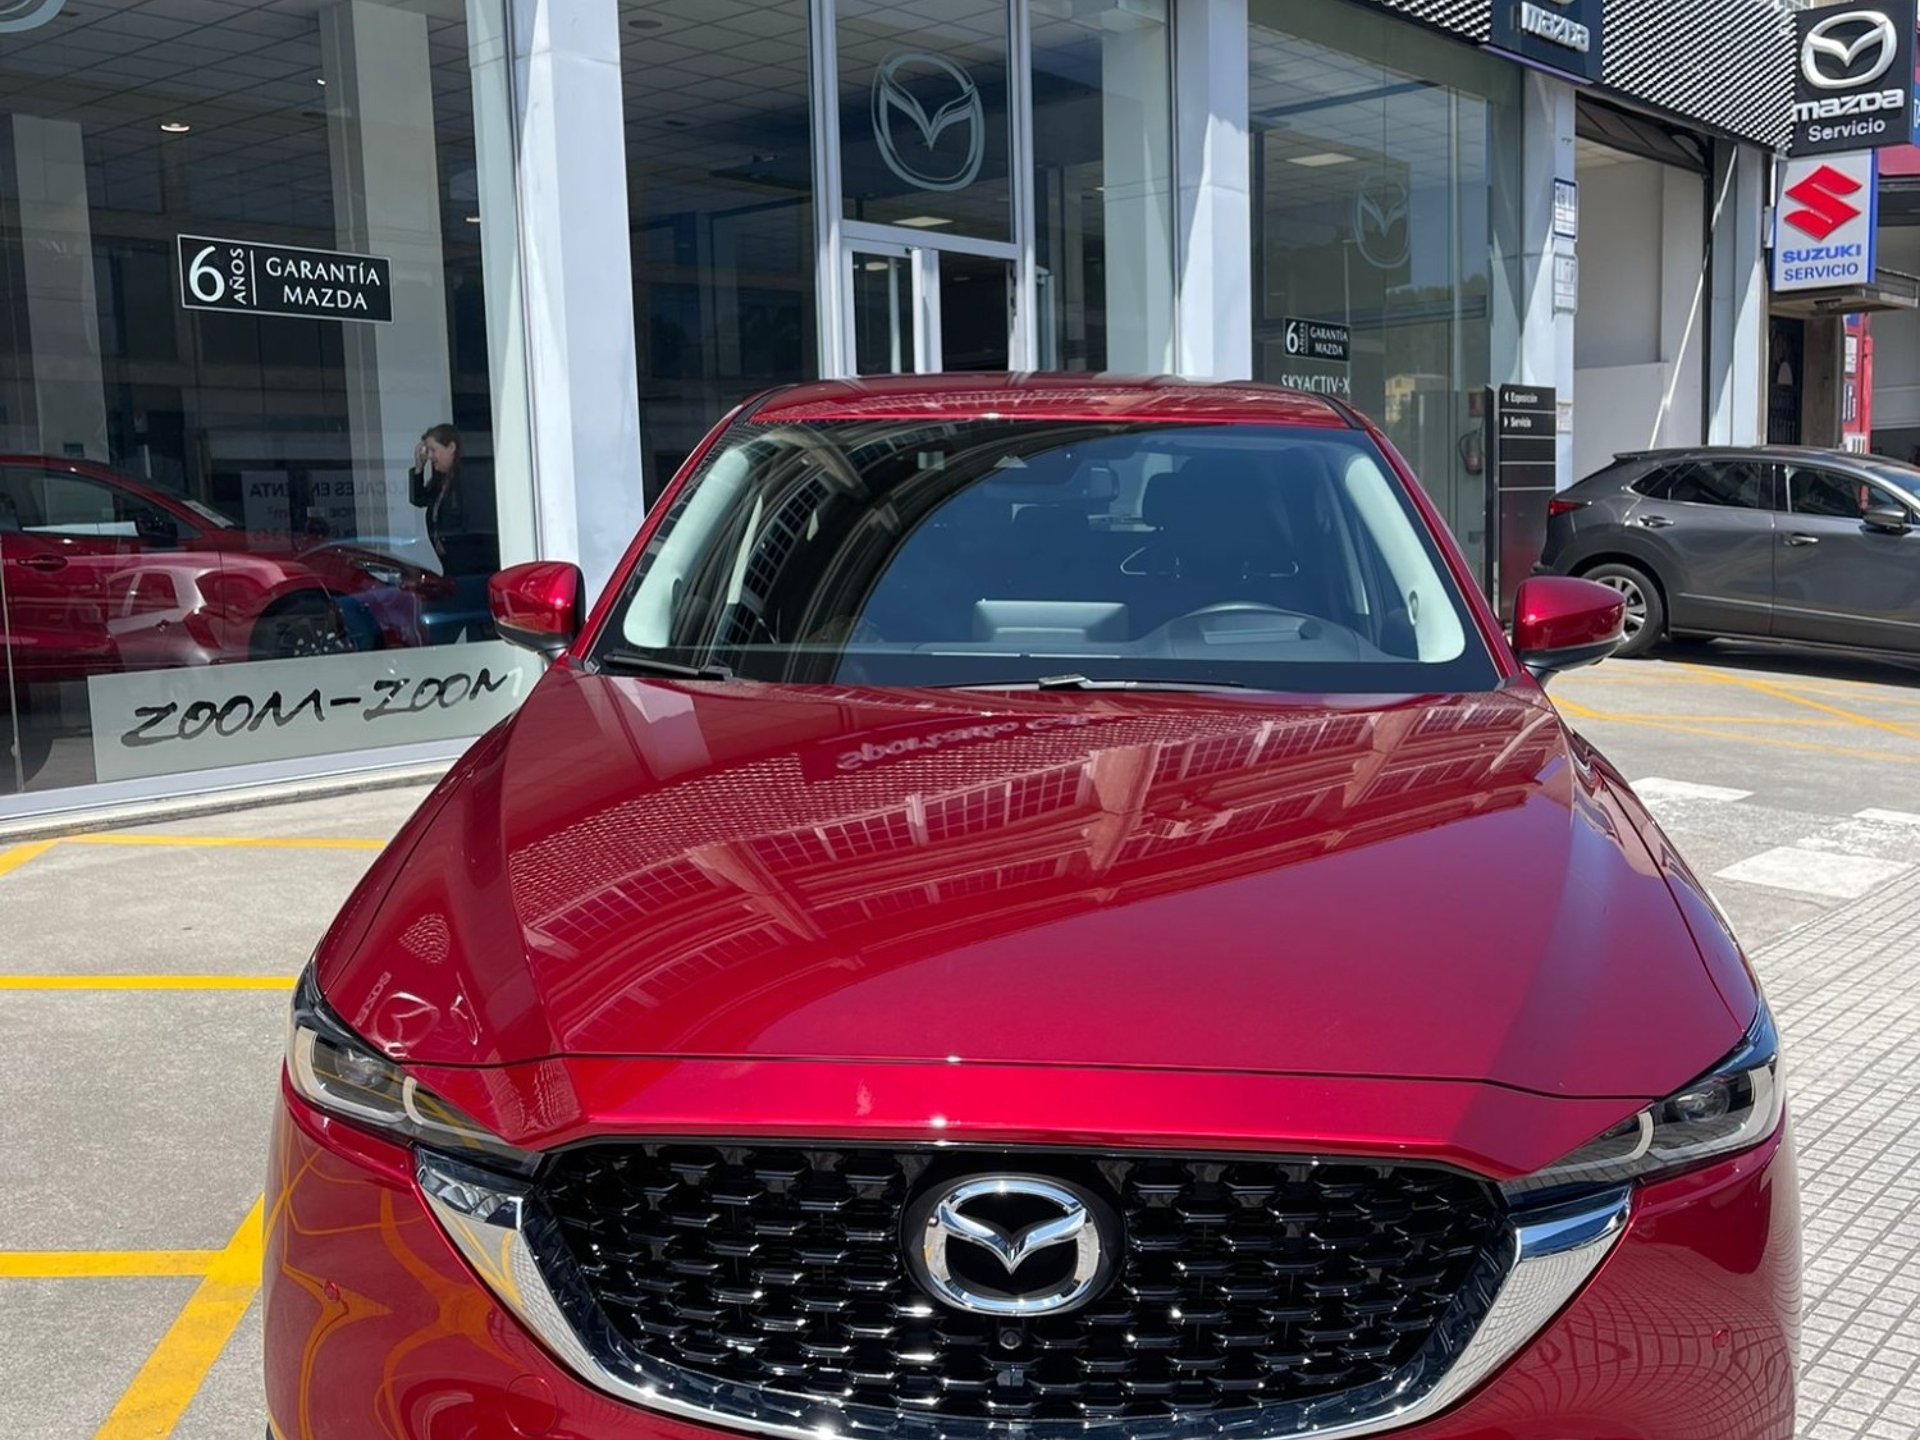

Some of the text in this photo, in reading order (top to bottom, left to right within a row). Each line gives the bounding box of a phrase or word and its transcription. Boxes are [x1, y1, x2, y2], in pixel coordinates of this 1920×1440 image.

[1521, 1, 1590, 52] mazda
[1791, 88, 1905, 122] mazda
[1808, 118, 1886, 142] Servicio
[1782, 243, 1862, 264] SUZUKI
[189, 246, 247, 305] 6 AÑOS
[265, 257, 381, 287] GARANTÍA
[1784, 262, 1859, 282] SERVICIO
[283, 285, 368, 311] MAZDA
[1286, 321, 1299, 353] 6
[1315, 342, 1344, 356] MAZDA
[1281, 374, 1350, 394] SKYACTIV-X
[120, 667, 524, 748] ZOOM-ZOOM
